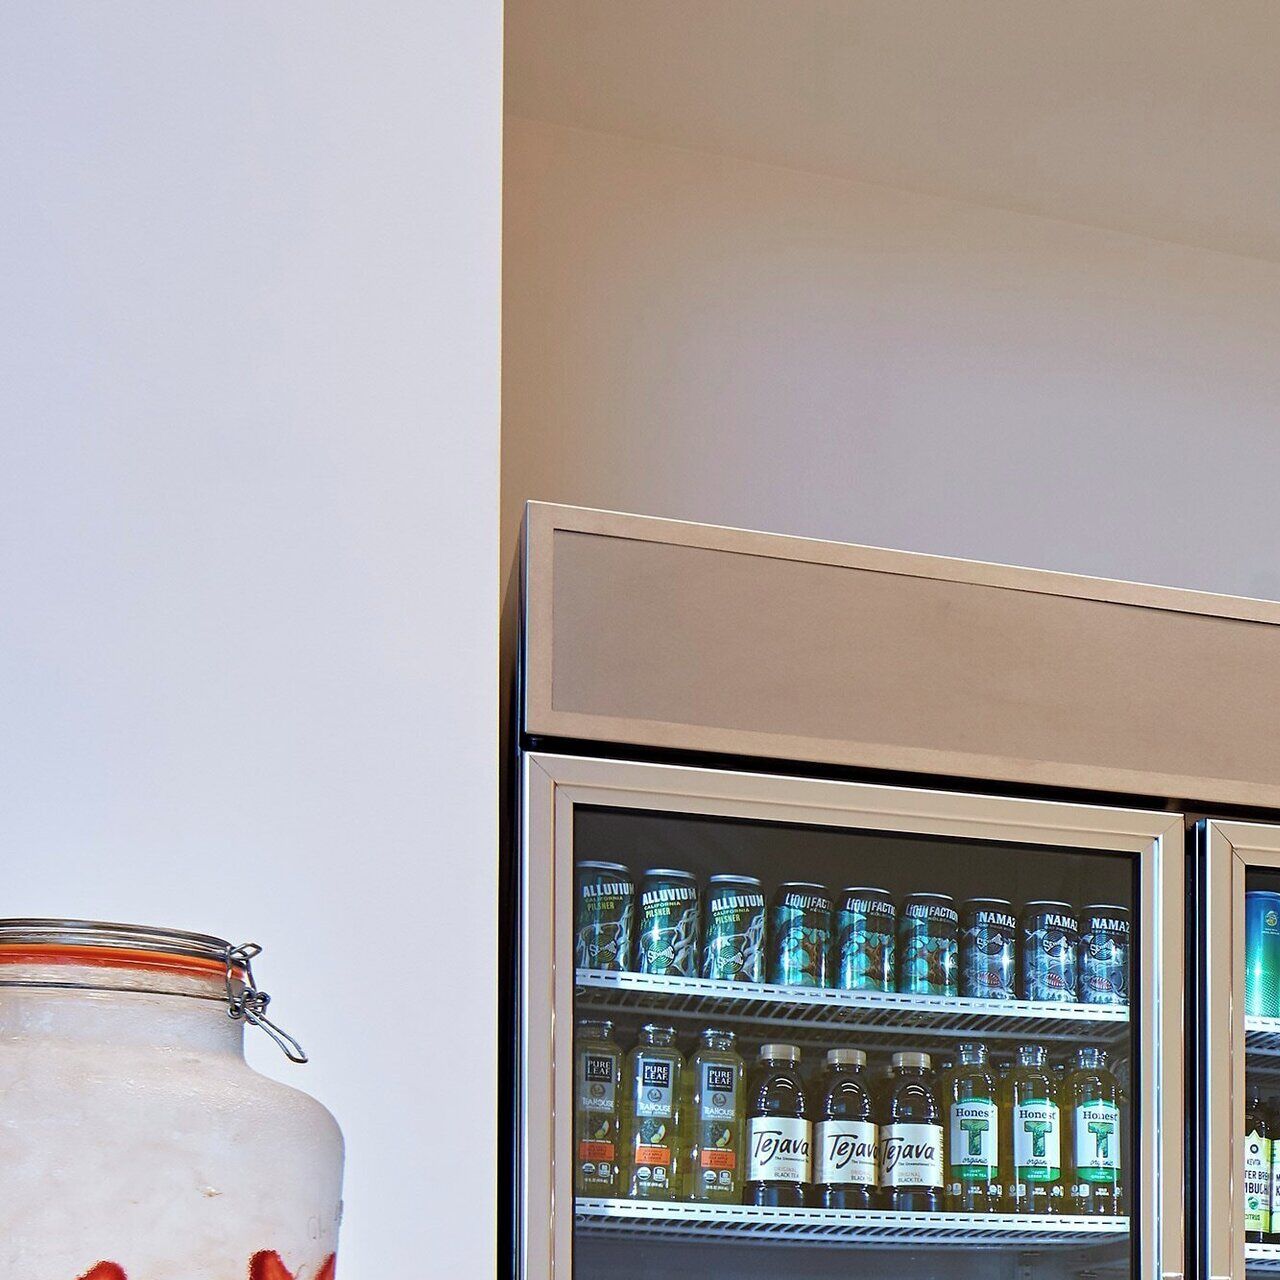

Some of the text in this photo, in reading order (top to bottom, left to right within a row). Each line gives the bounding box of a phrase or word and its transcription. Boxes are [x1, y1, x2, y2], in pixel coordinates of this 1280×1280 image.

[642, 888, 696, 905] ALLUVIUM
[711, 894, 764, 912] ALLUVIUM
[645, 907, 671, 919] PILSNER
[715, 913, 740, 924] PILSNER
[588, 1060, 610, 1068] PURE
[588, 1067, 610, 1075] LEAF
[645, 1072, 667, 1080] LEAF
[709, 1077, 731, 1085] LEAF
[1083, 1111, 1117, 1121] Honest
[960, 1119, 989, 1155] T
[1024, 1121, 1052, 1157] T
[754, 1130, 809, 1165] Tejava
[881, 1138, 935, 1173] Tejava
